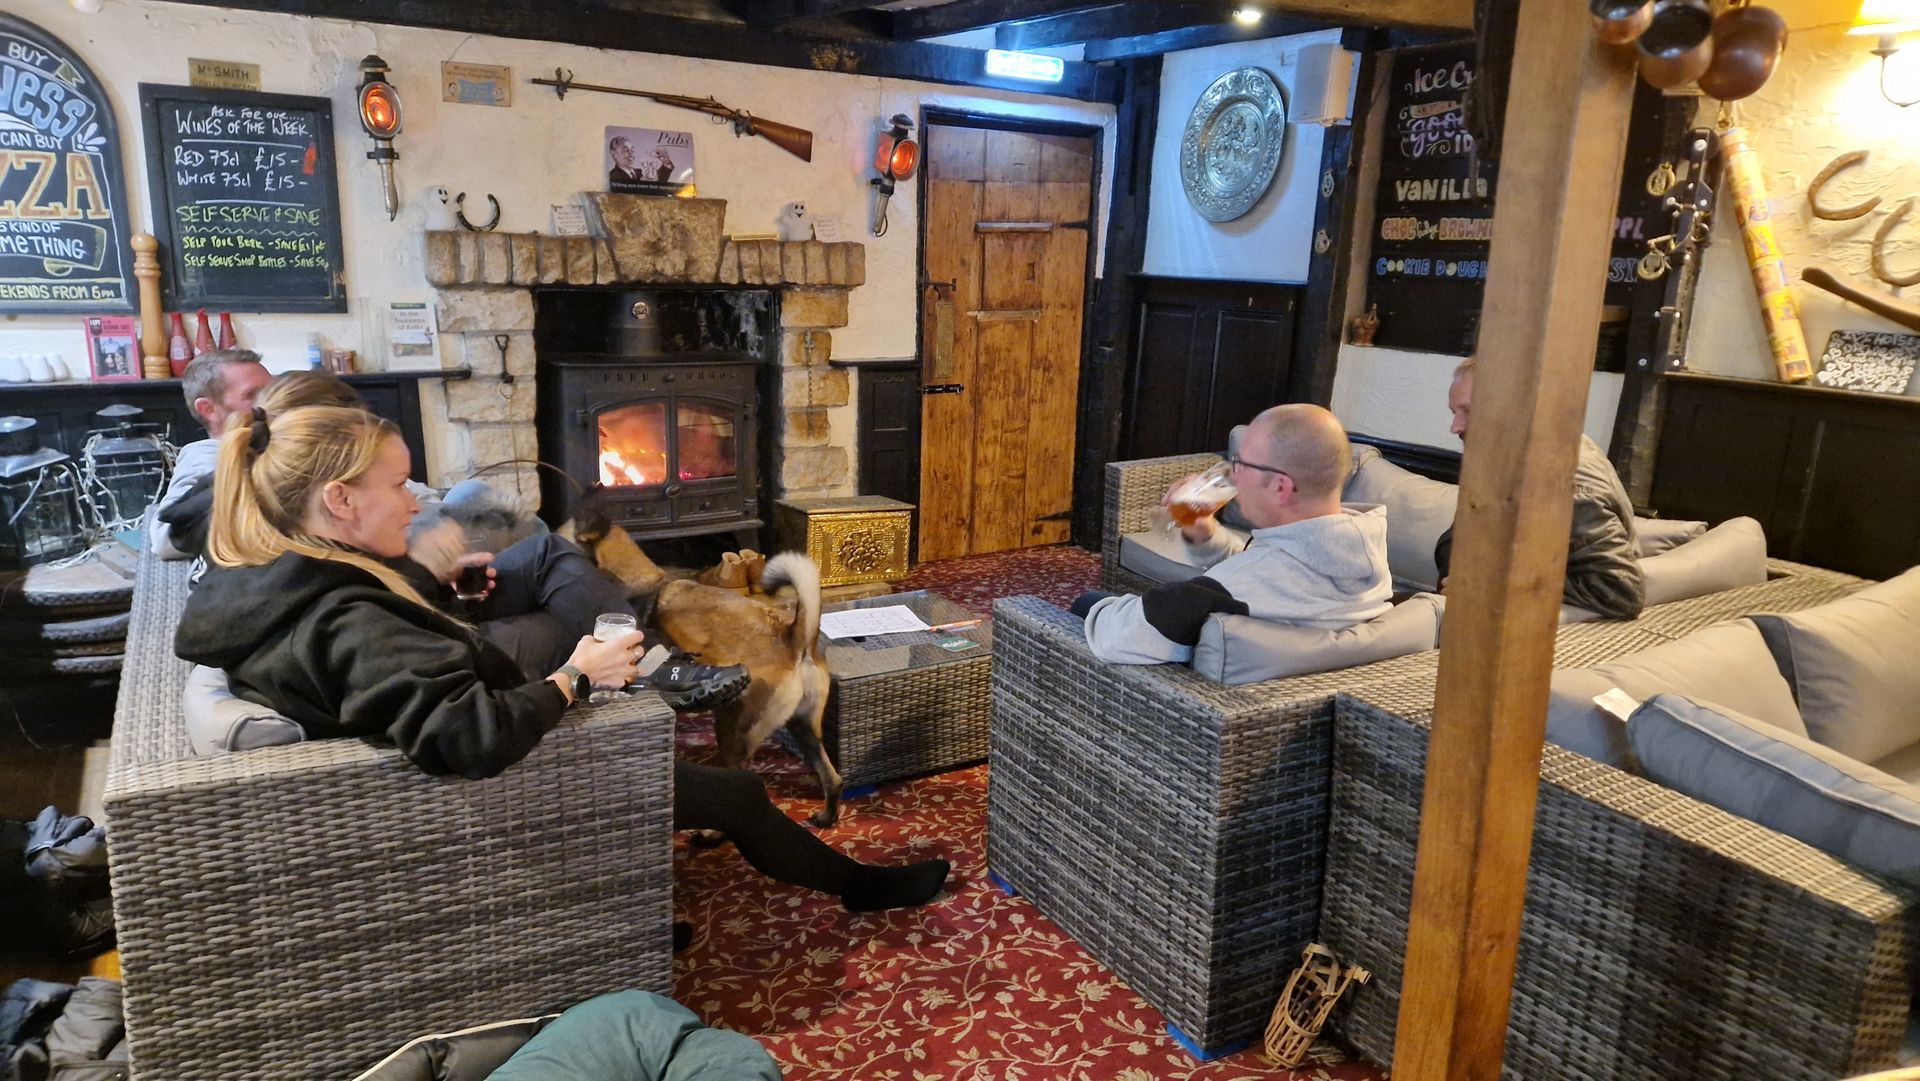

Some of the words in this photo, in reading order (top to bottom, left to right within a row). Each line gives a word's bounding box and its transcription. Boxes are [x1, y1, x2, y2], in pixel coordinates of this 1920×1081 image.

[8, 41, 48, 66] BUY
[214, 66, 249, 80] SMITH
[175, 109, 221, 136] WINES
[227, 120, 240, 134] OF
[242, 119, 265, 134] THE
[0, 131, 32, 148] CAN
[34, 132, 63, 151] BUY
[658, 131, 689, 146] Pubs
[174, 145, 204, 167] RED
[177, 170, 216, 186] WHITE
[284, 208, 320, 226] SAVE
[42, 221, 61, 233] OF
[1376, 257, 1431, 276] COOKIE
[52, 285, 88, 299] FROM
